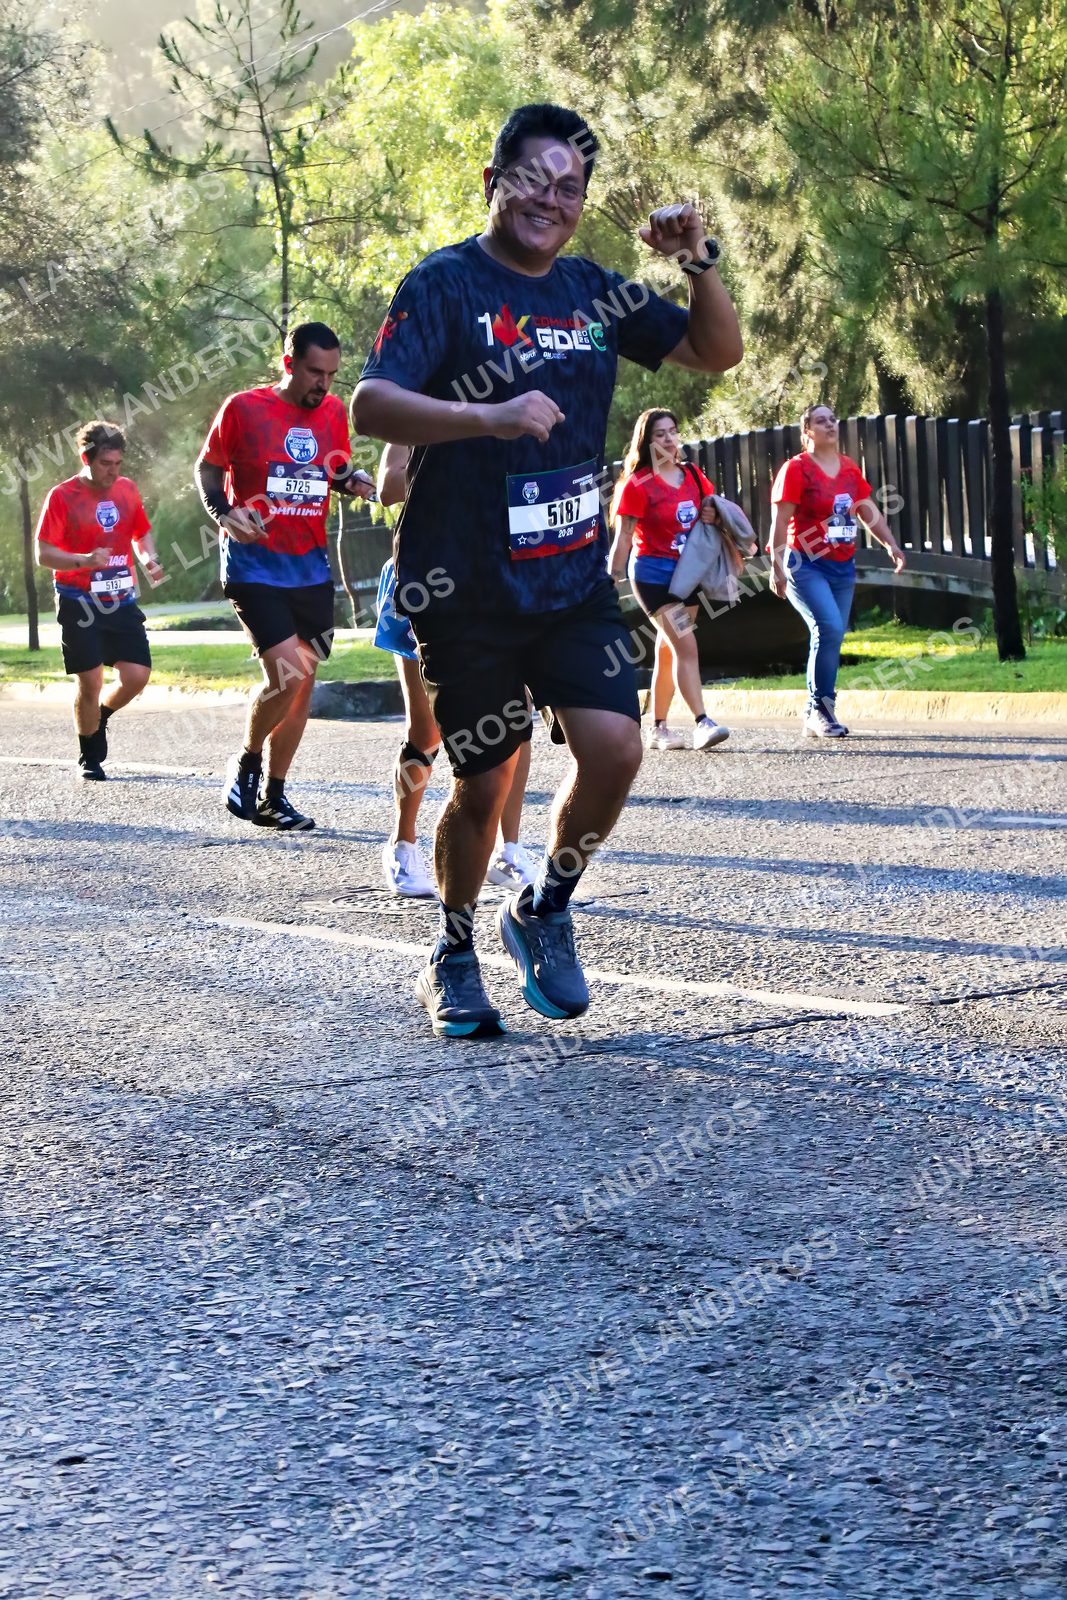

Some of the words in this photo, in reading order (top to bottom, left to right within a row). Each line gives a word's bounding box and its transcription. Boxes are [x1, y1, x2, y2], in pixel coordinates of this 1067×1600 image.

[536, 327, 591, 350] GDL
[286, 480, 310, 494] 5725
[547, 497, 581, 527] 5187
